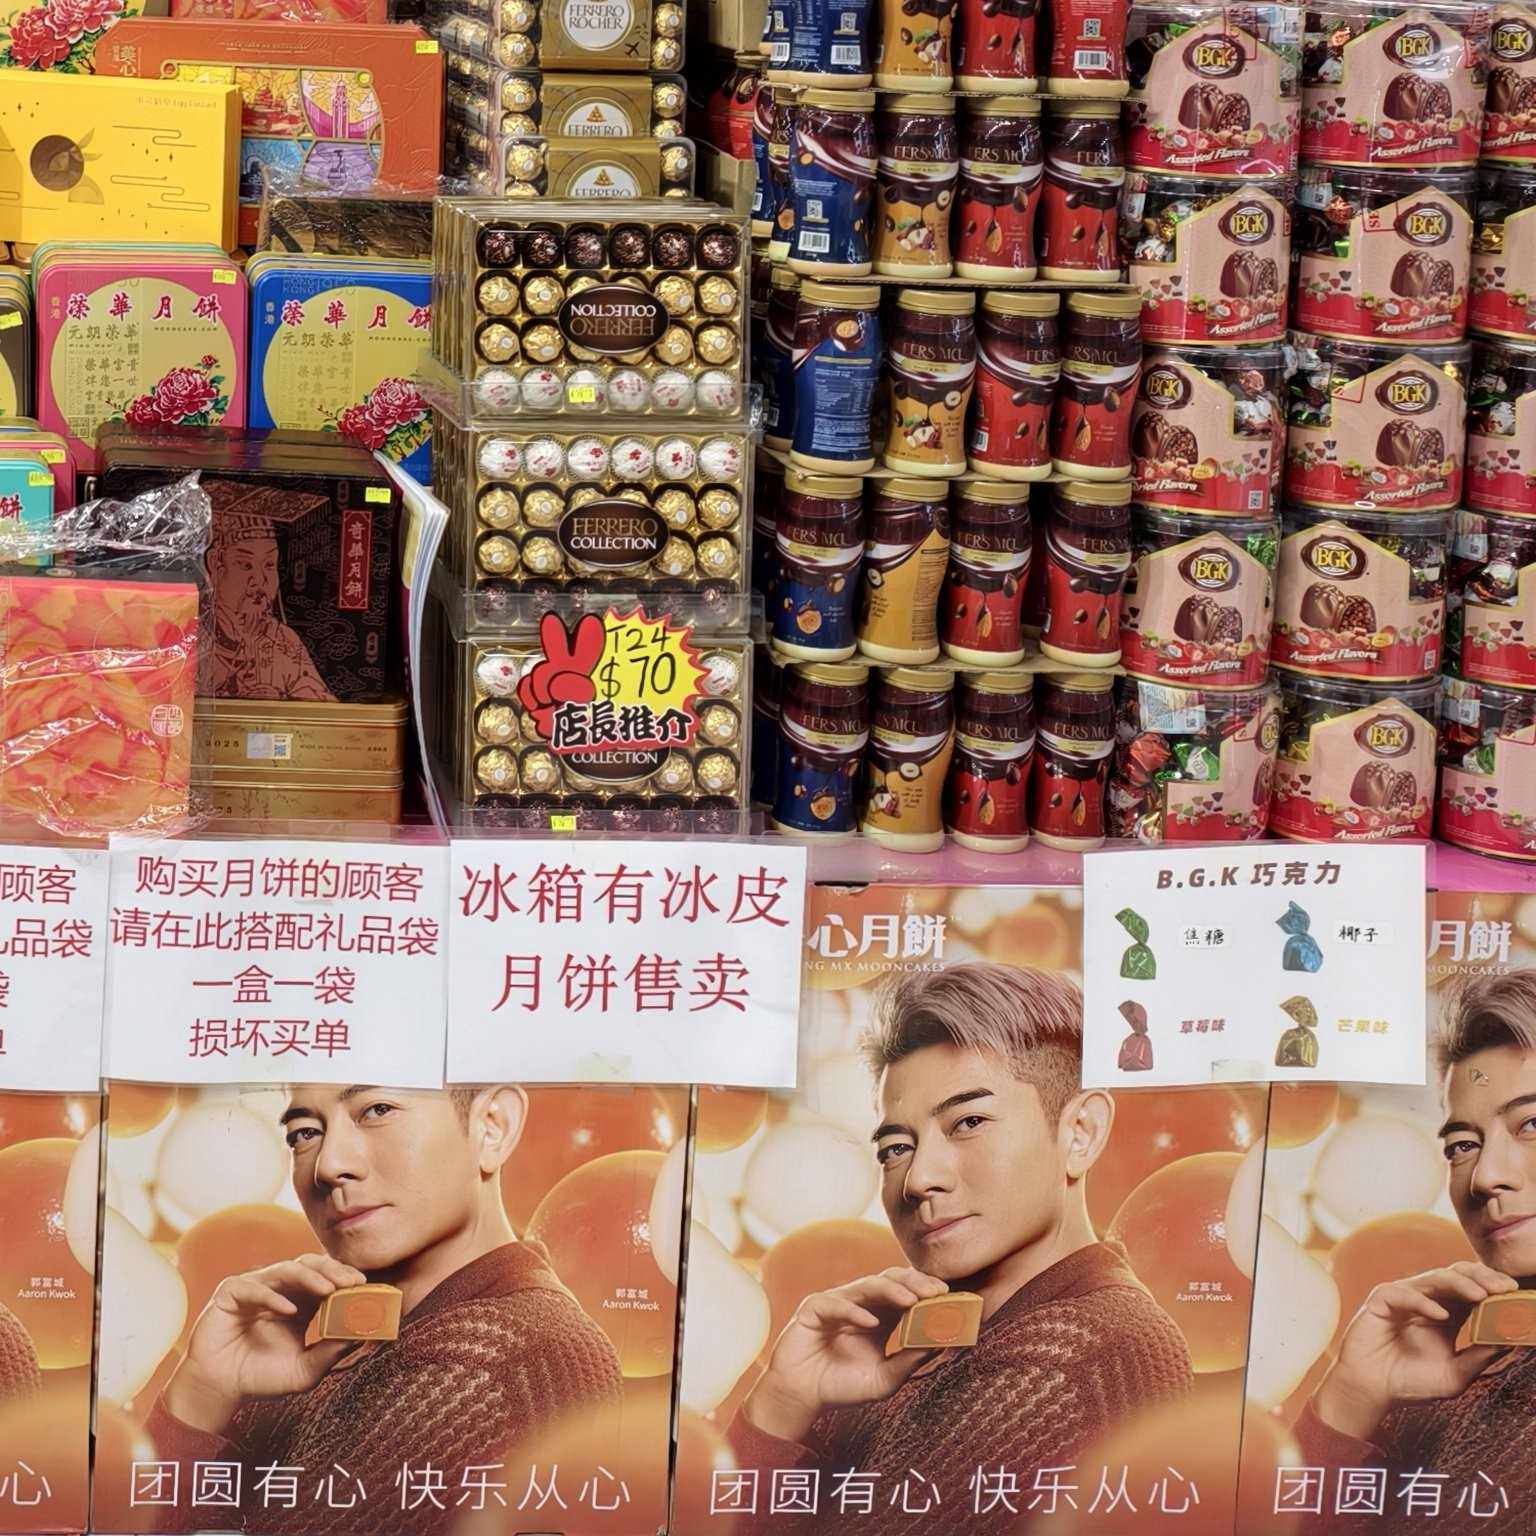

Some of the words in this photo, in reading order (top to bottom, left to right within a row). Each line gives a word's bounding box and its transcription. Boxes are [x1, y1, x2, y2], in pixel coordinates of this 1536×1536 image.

[1399, 35, 1434, 57] BGK
[68, 293, 223, 323] 榮華月餅
[571, 303, 657, 317] COLLECTION
[572, 518, 659, 537] FERRERO
[571, 537, 657, 552] COLLECTION
[1194, 559, 1229, 582] BGK
[600, 655, 677, 701] $70
[550, 703, 697, 748] 店長推介
[1368, 725, 1406, 748] BGK
[571, 750, 659, 765] COLLECTION
[136, 856, 424, 902] 购买月饼的顾客
[1156, 866, 1239, 890] B.G.K
[1250, 860, 1342, 887] 巧克力
[459, 861, 790, 929] 冰箱有冰皮
[111, 907, 439, 957] 请在此搭配礼品袋
[807, 914, 947, 959] 心月餅
[1183, 927, 1225, 946] 焦糖
[1338, 924, 1380, 943] 椰子
[1426, 920, 1512, 962] 月餅
[856, 962, 945, 972] MOONCAKES
[192, 964, 356, 1007] 一盒一袋
[491, 951, 750, 1014] 月饼售卖
[189, 1017, 351, 1059] 损坏买单
[1179, 1018, 1227, 1035] 草莓味
[1337, 1019, 1390, 1035] 芒果味
[129, 1459, 369, 1511] 团圆有心
[395, 1460, 632, 1515] 快乐从心
[709, 1466, 943, 1517] 团圆有心
[970, 1466, 1202, 1517] 快乐从心
[1273, 1467, 1511, 1520] 团圆有心
